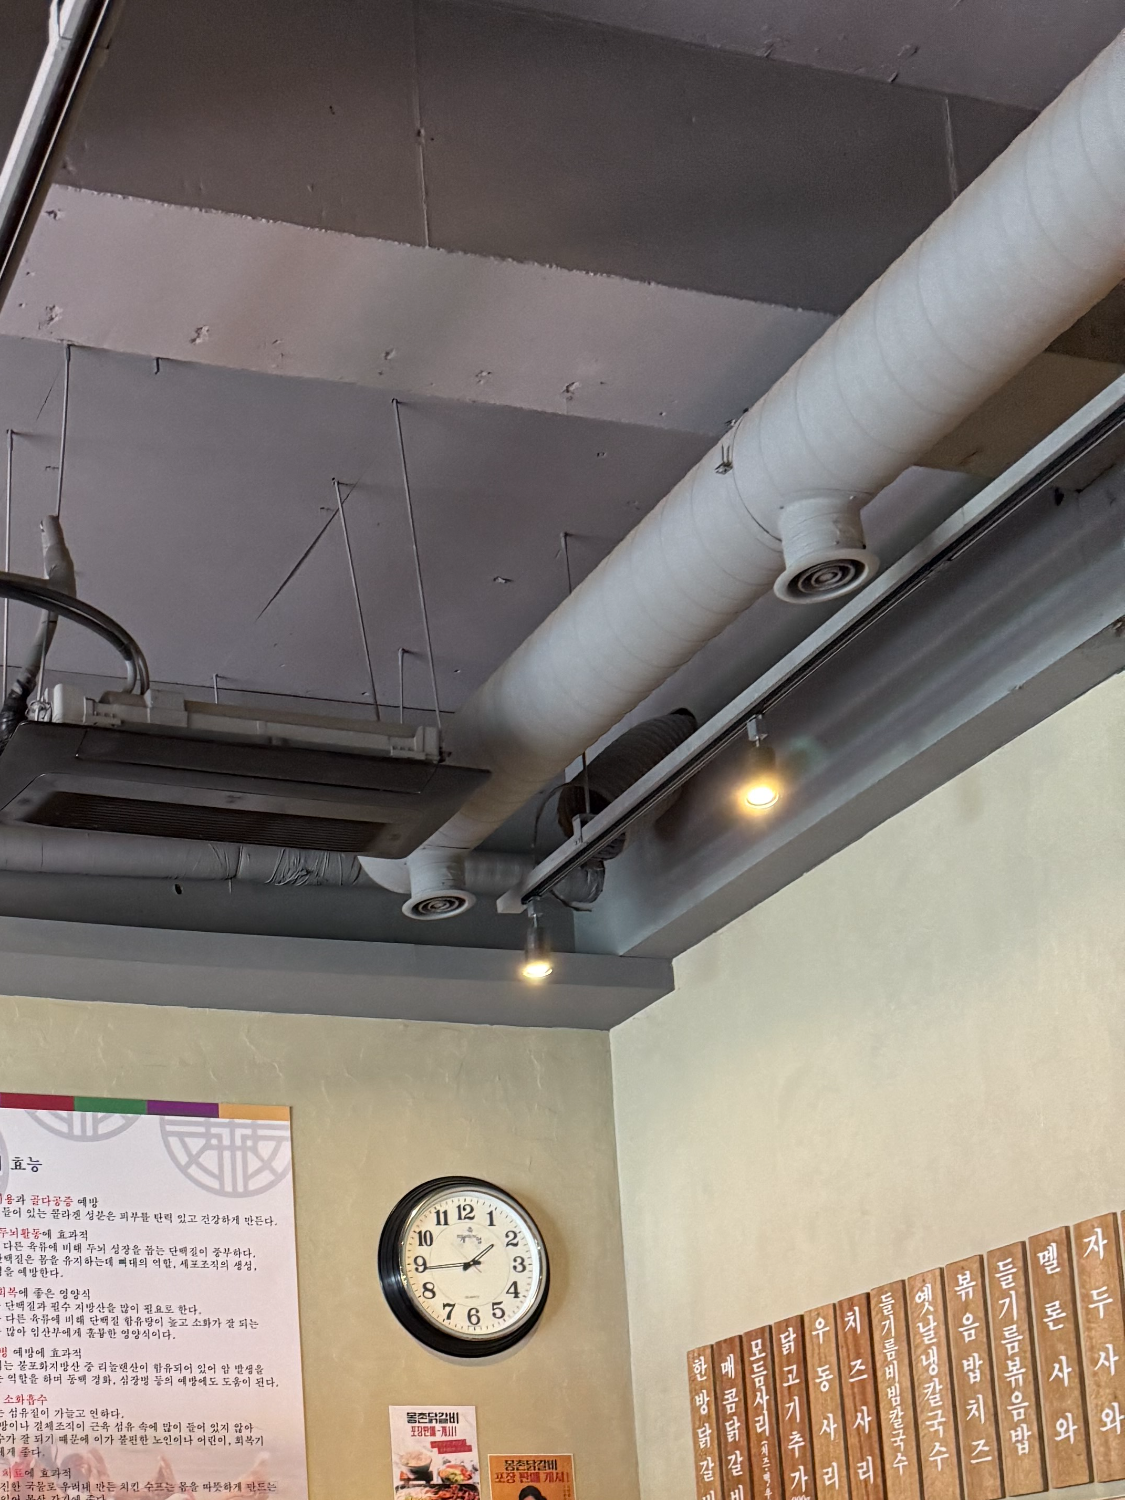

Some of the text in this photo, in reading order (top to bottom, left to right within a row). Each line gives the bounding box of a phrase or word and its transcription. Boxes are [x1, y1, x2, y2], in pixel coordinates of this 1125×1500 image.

[9, 1155, 43, 1173] 효능
[29, 1194, 74, 1207] 골다공증
[76, 1195, 99, 1208] 예방
[434, 1209, 449, 1226] 11
[456, 1203, 476, 1221] 12
[487, 1210, 496, 1227] 1
[56, 1228, 88, 1241] 효과적
[417, 1230, 434, 1247] 10
[505, 1230, 520, 1248] 2
[17, 1266, 63, 1279] 예방한다.
[413, 1255, 428, 1274] 9
[512, 1256, 526, 1273] 3
[32, 1287, 55, 1299] 좋은
[58, 1287, 90, 1300] 영양식
[422, 1282, 437, 1300] 8
[506, 1281, 520, 1299] 4
[4, 1299, 47, 1312] 단백질과
[74, 1301, 116, 1314] 지방산을
[119, 1302, 139, 1314] 많이
[177, 1303, 201, 1316] 한다.
[442, 1303, 457, 1320] 7
[491, 1301, 506, 1319] 5
[467, 1307, 481, 1326] 6
[1083, 1227, 1124, 1435] 자두사와
[1037, 1242, 1078, 1444] 멜론사와
[12, 1346, 45, 1359] 예방에
[49, 1346, 81, 1359] 효과적
[994, 1257, 1031, 1456] 들기름볶음밥
[954, 1270, 993, 1464] 볶음밥치즈
[7, 1372, 39, 1384] 역할을
[42, 1373, 62, 1385] 하며
[66, 1373, 87, 1385] 동맥
[177, 1375, 219, 1387] 예방에도
[221, 1375, 251, 1387] 도움이
[254, 1376, 278, 1388] 된다.
[879, 1292, 909, 1475] 들기름비빔칼국수
[914, 1283, 949, 1472] 옛날냉칼국수
[749, 1339, 771, 1438] 모듬사리
[844, 1306, 874, 1486] 치즈사리
[2, 1393, 48, 1405] 소화흡수
[811, 1317, 840, 1490] 우동사리
[8, 1406, 49, 1419] 섬유질이
[53, 1407, 85, 1419] 가늘고
[406, 1412, 459, 1424] 몽촌닭갈비
[779, 1327, 809, 1492] 닭고기추가
[89, 1420, 111, 1432] 근육
[114, 1421, 135, 1432] 섬유
[138, 1421, 158, 1432] 속에
[162, 1421, 182, 1433] 많이
[185, 1421, 206, 1433] 들어
[209, 1421, 229, 1433] 있지
[19, 1433, 30, 1444] 잘
[33, 1433, 54, 1444] 되기
[58, 1433, 89, 1445] 때문에
[93, 1433, 115, 1445] 이가
[117, 1433, 149, 1445] 불편한
[196, 1434, 231, 1446] 어린이,
[234, 1434, 264, 1446] 회복기
[19, 1446, 46, 1457] 좋다.
[39, 1467, 71, 1479] 효과적
[504, 1459, 558, 1471] 몽촌닭갈비
[494, 1472, 516, 1483] 포장
[519, 1472, 541, 1483] 판매
